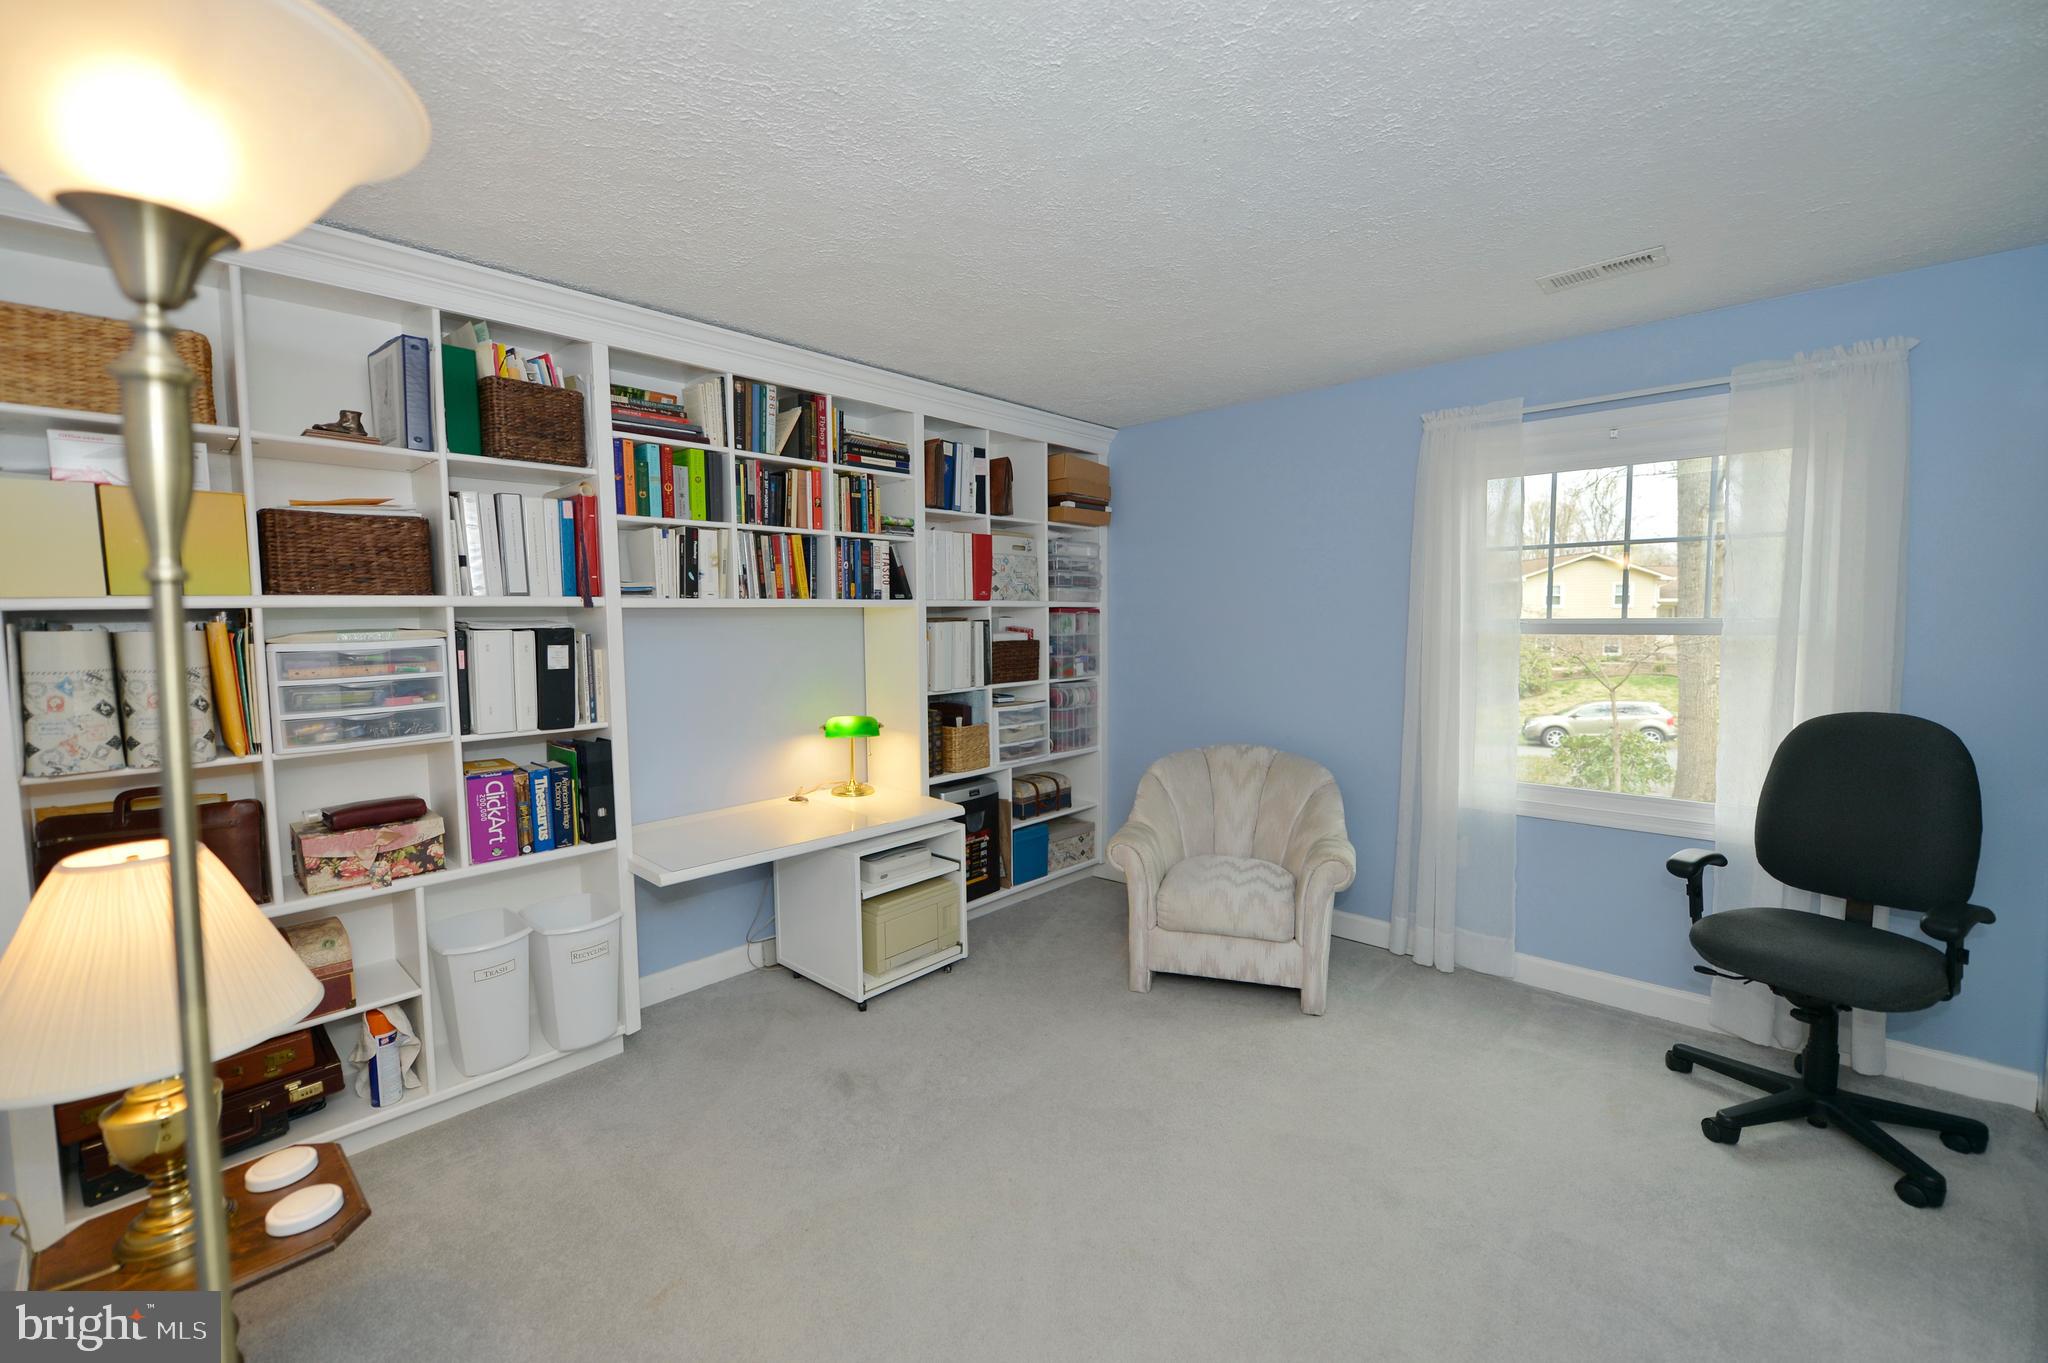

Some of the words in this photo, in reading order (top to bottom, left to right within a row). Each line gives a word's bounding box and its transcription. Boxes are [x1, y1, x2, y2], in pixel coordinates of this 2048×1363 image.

[882, 552, 890, 586] FIASCO
[479, 793, 488, 822] 200,000
[535, 775, 549, 841] Thesaurus
[561, 777, 570, 805] American
[485, 780, 506, 845] ClickArt
